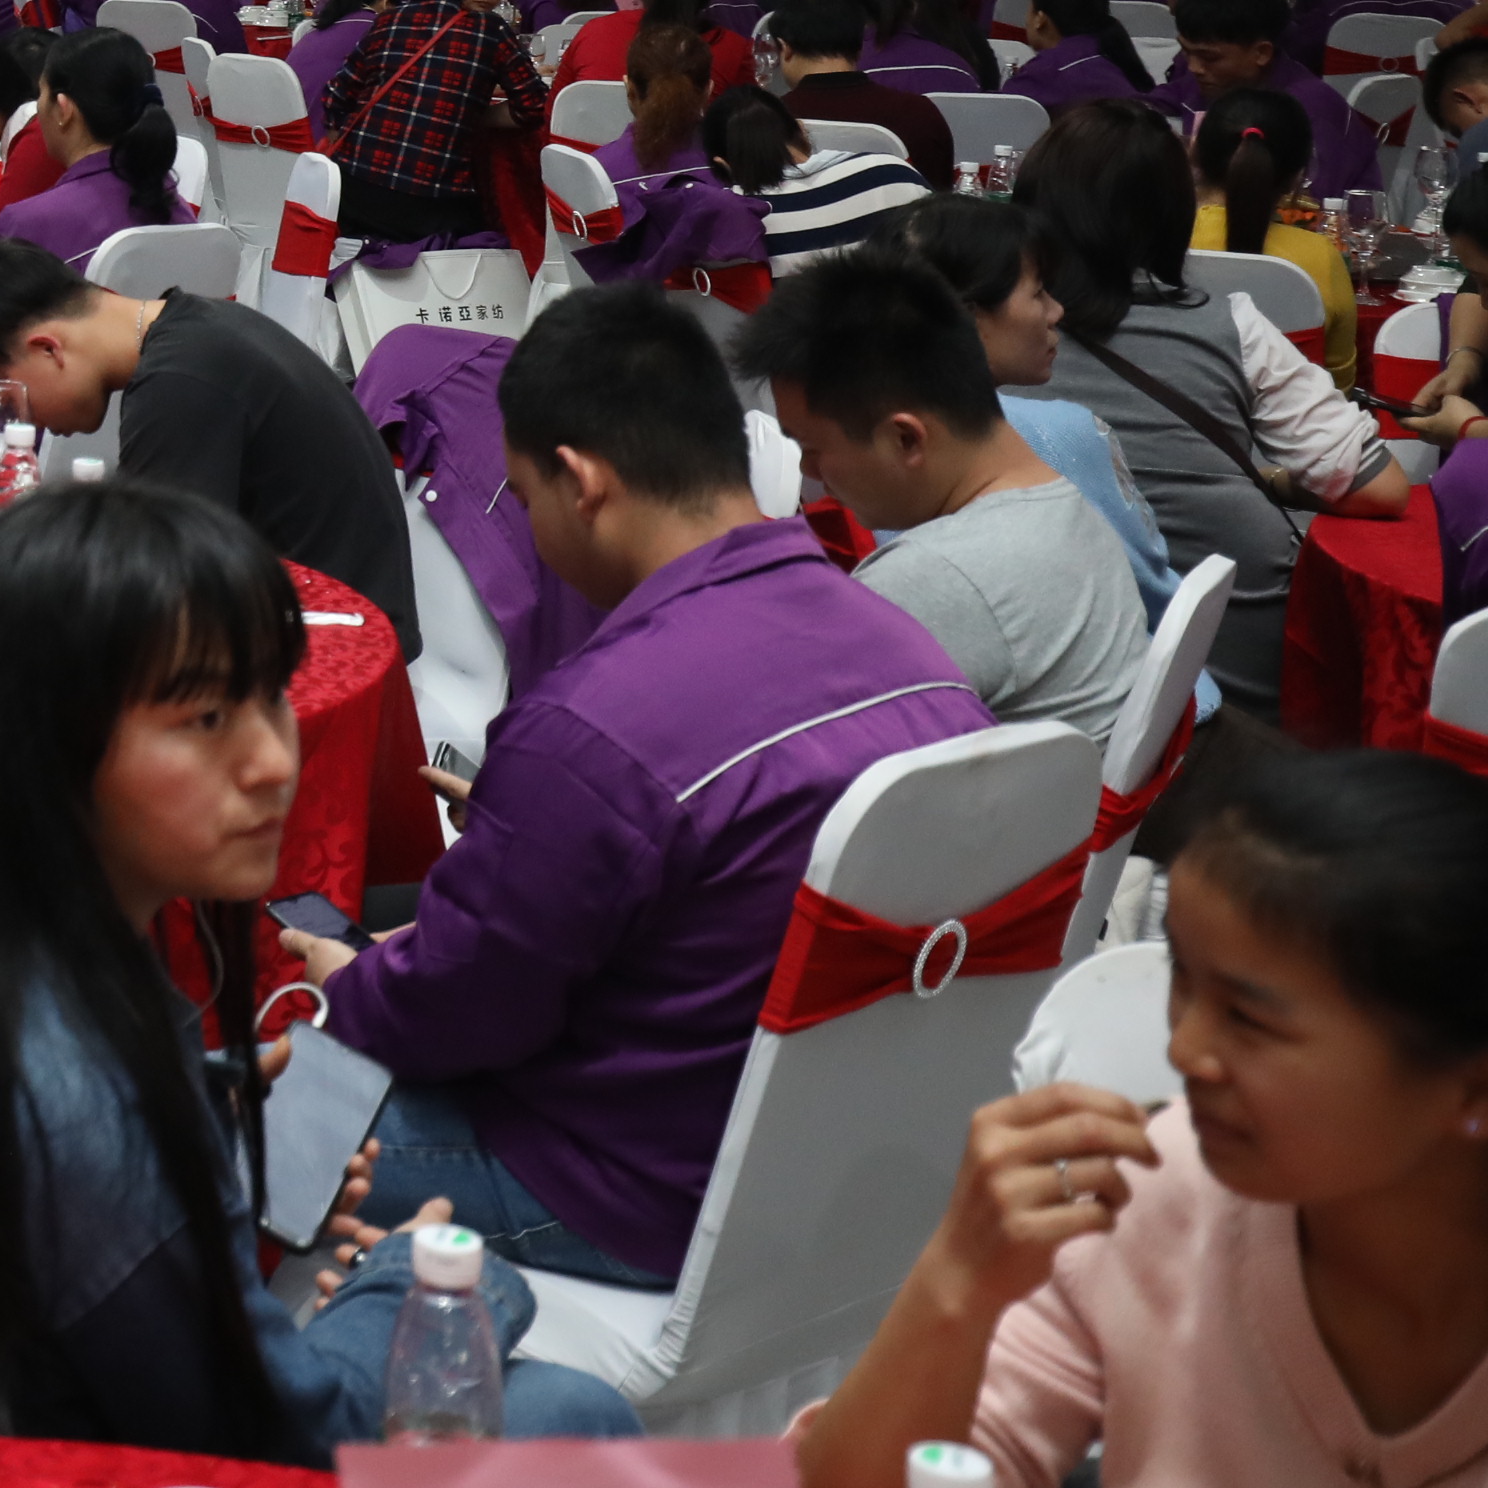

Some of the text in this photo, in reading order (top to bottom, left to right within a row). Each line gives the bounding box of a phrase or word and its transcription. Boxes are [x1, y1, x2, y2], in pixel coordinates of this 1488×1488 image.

[415, 304, 504, 325] 卡诺亞家纺
